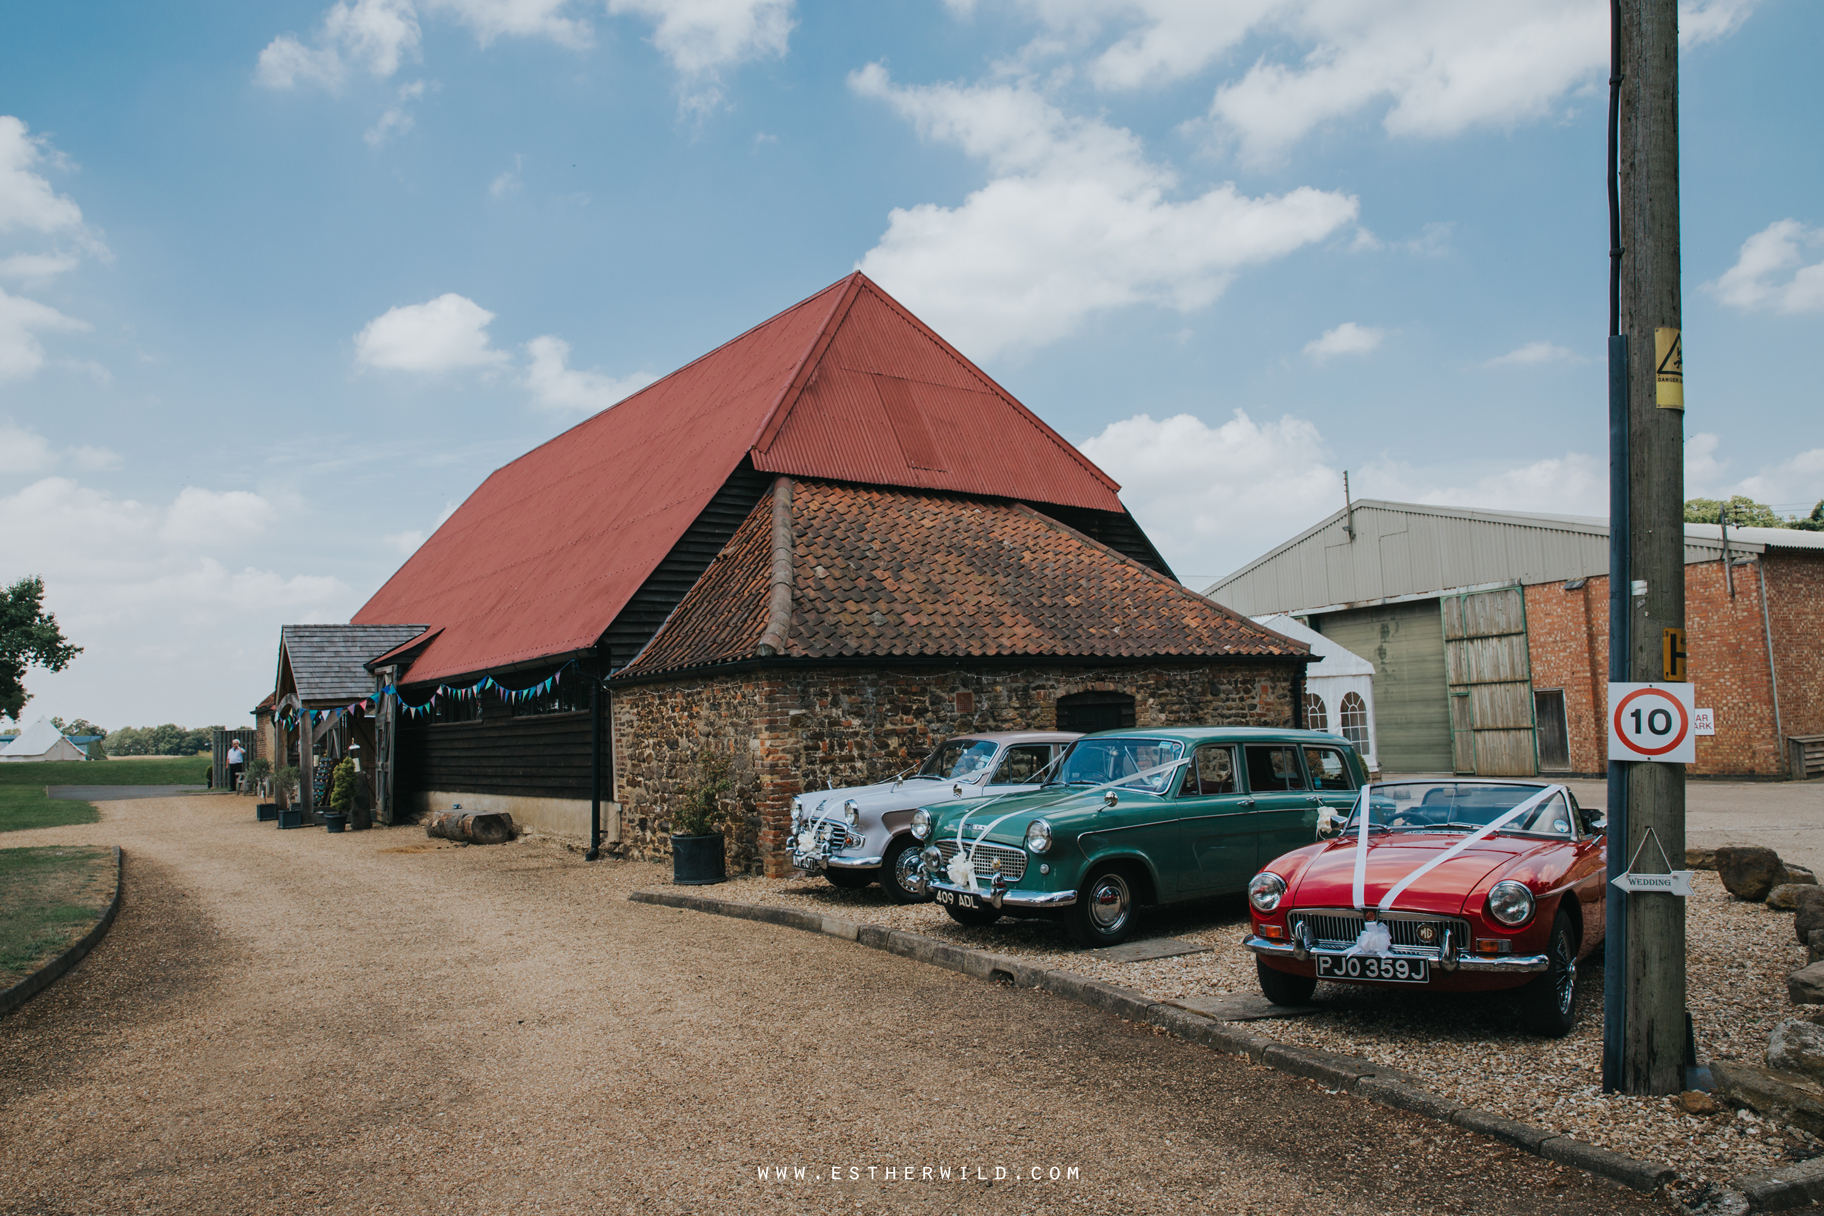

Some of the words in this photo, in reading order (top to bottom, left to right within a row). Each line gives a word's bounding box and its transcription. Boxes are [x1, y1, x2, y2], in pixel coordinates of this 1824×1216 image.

[1630, 708, 1672, 736] 10
[1695, 714, 1709, 722] AR
[1694, 722, 1712, 730] ARK
[1628, 877, 1671, 886] WEDDING
[936, 890, 954, 905] 409
[958, 893, 979, 910] ADL
[1420, 927, 1433, 939] MG
